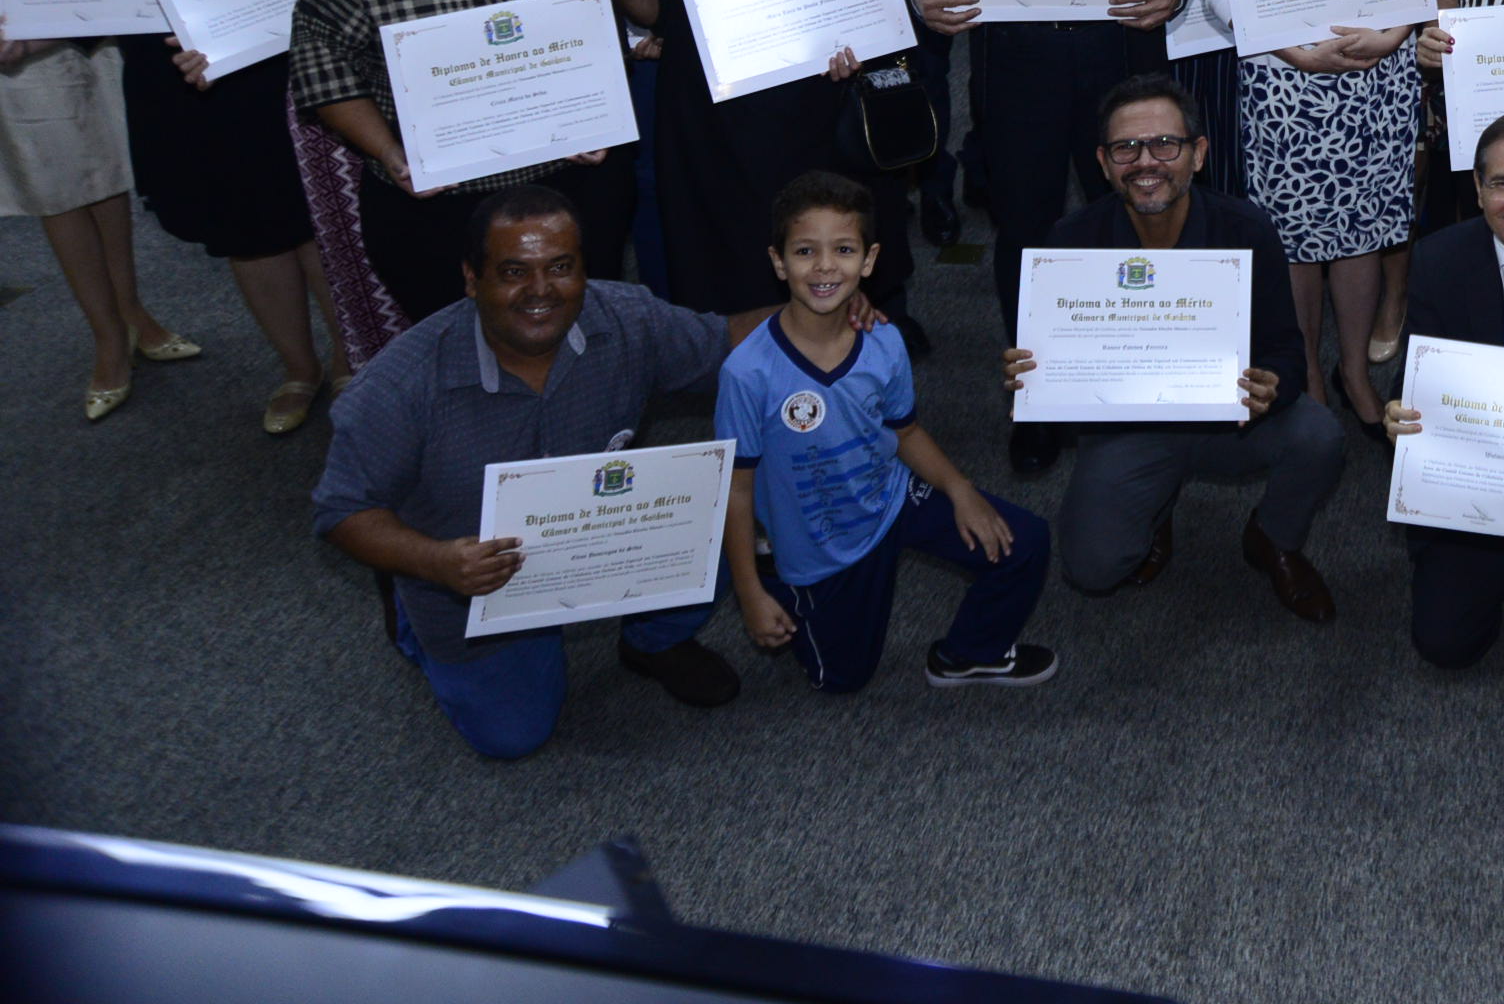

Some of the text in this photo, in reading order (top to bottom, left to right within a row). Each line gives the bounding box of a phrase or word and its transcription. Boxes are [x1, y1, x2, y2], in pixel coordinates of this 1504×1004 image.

[430, 39, 584, 78] Diploma de Honra ao Mérito
[1057, 297, 1213, 309] Diploma de Honra ao Mérito
[525, 495, 691, 527] Diploma de Honra ao Mérito
